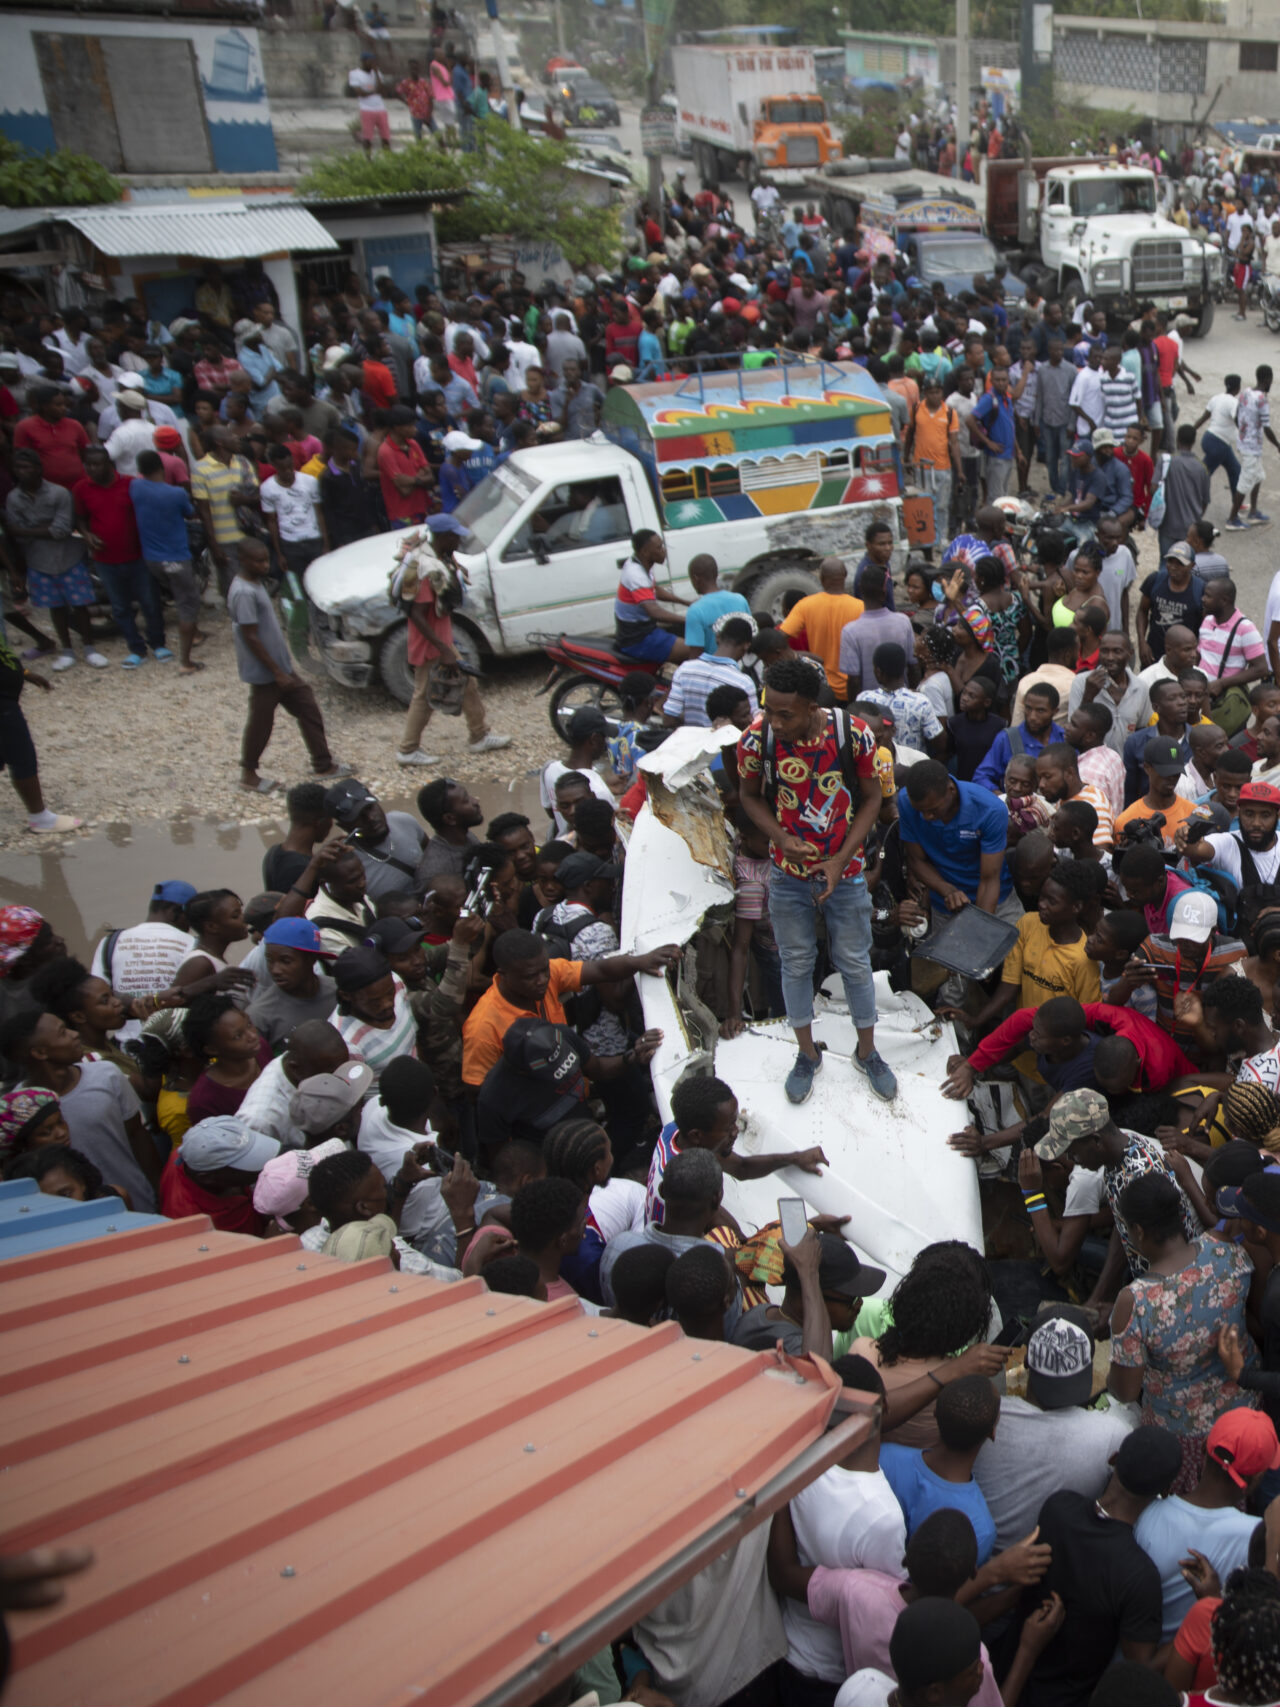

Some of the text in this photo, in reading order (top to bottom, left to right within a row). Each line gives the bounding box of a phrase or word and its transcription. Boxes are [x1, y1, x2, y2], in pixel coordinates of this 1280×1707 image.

[121, 975, 161, 984] Watching
[119, 982, 166, 991] Curtain Go
